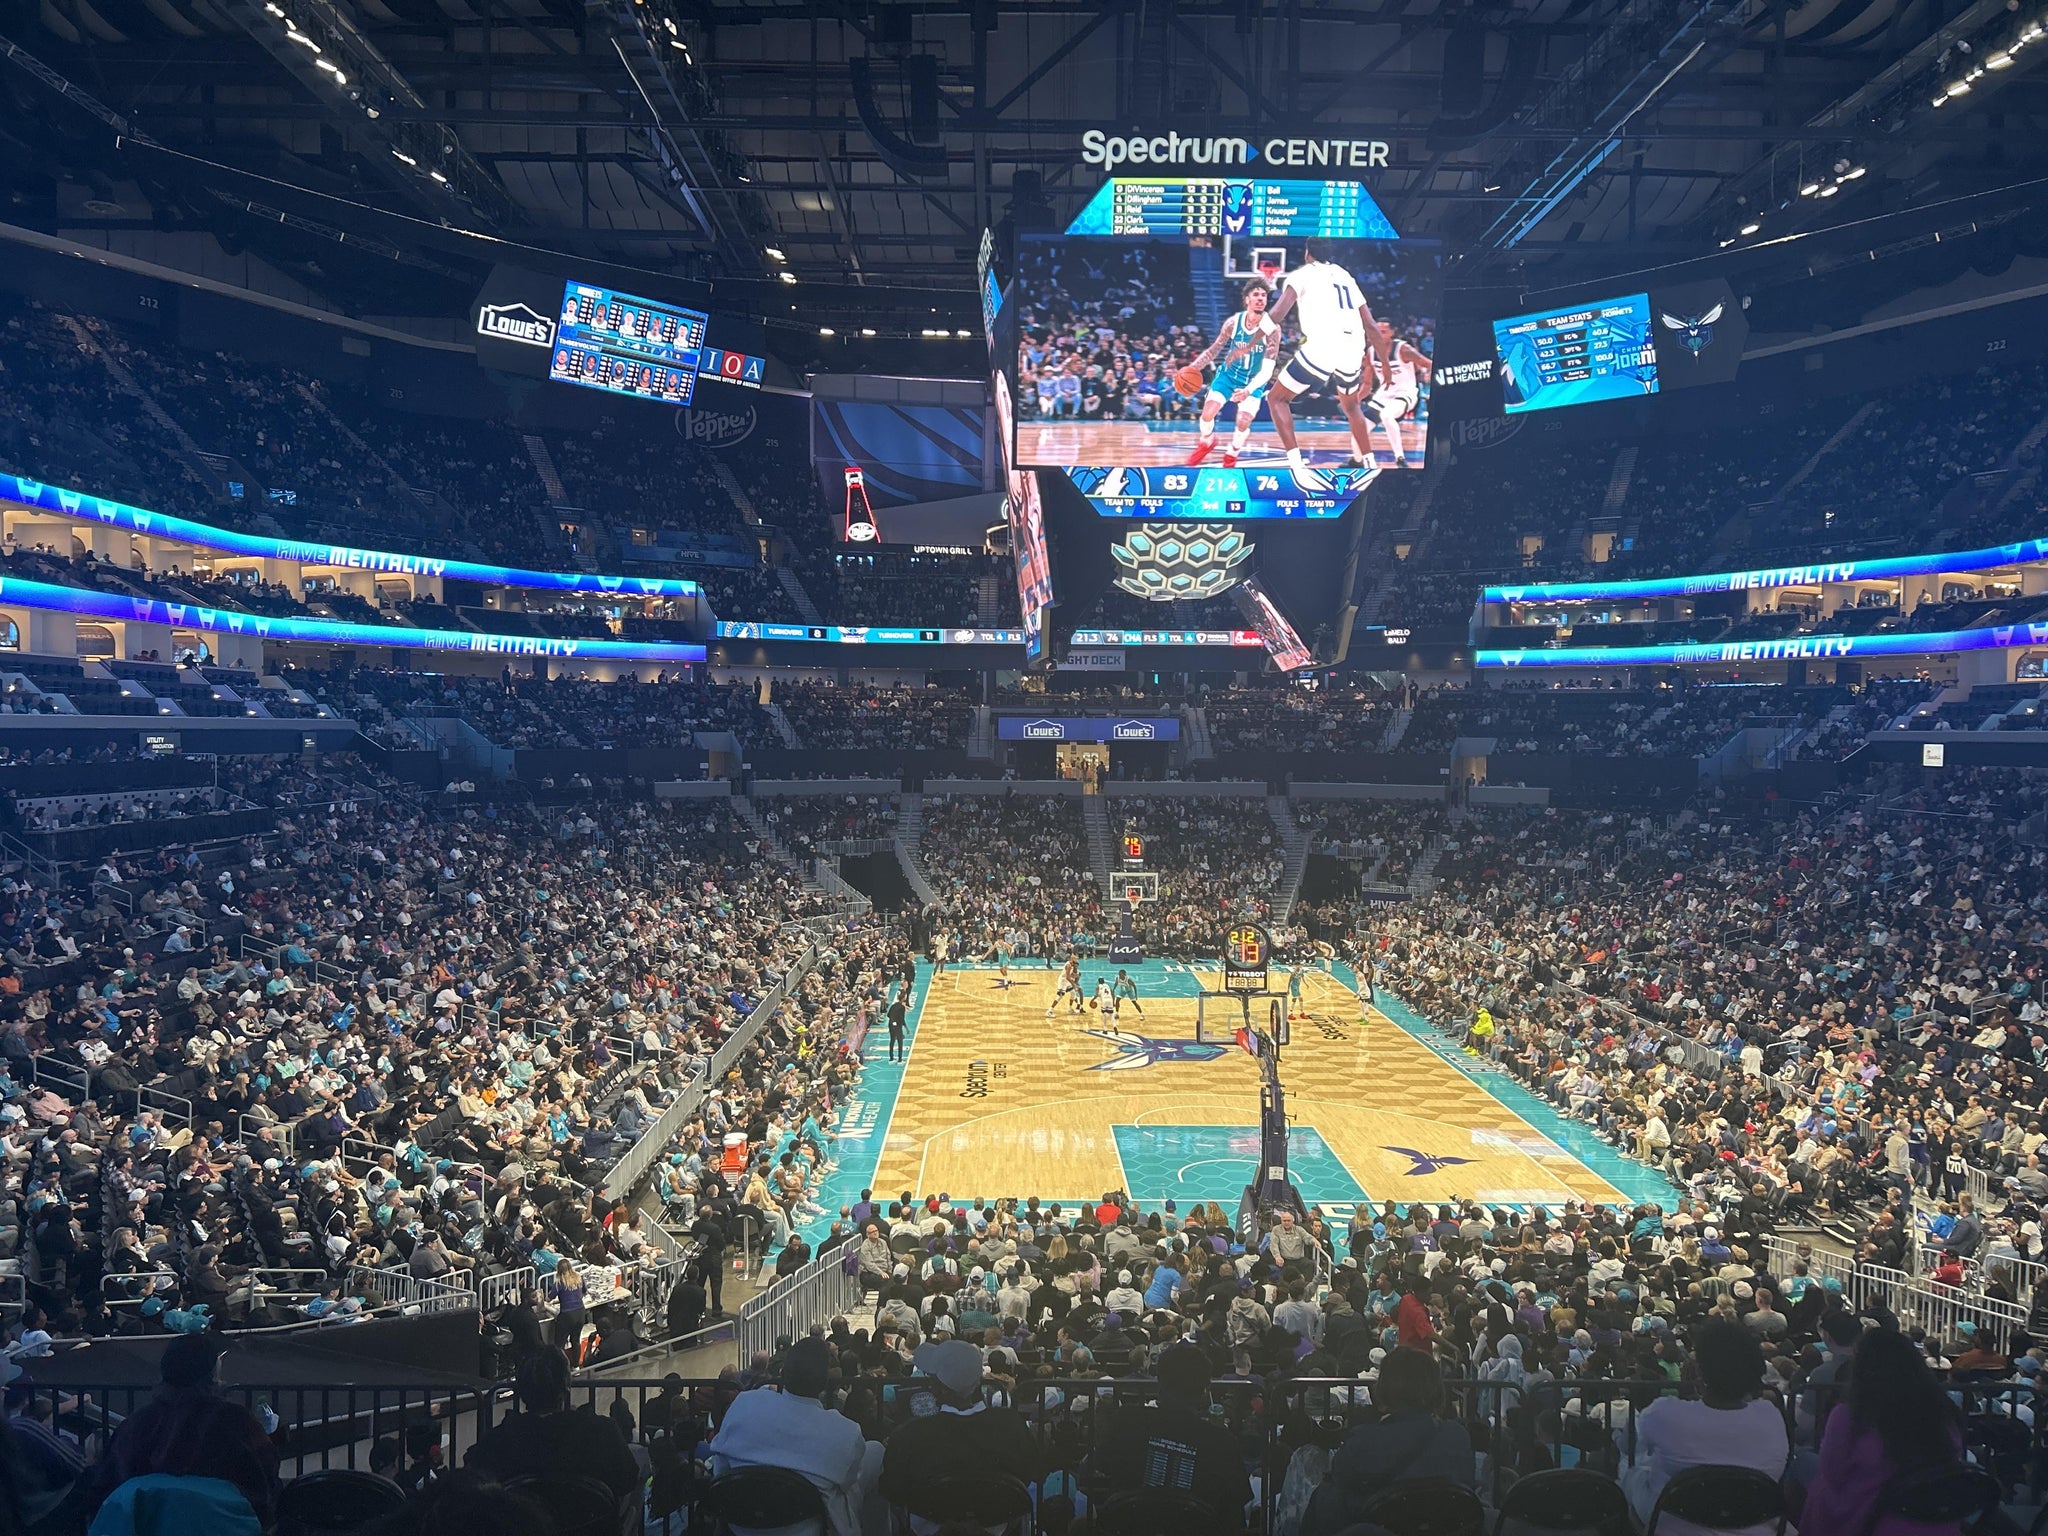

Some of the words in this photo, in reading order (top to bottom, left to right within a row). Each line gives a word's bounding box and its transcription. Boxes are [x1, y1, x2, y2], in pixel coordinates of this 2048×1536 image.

[1082, 130, 1249, 172] Spectrum
[1265, 139, 1390, 168] CENTER
[1116, 185, 1123, 193] 0
[1267, 186, 1281, 195] Ball
[1267, 197, 1289, 205] James
[1127, 205, 1142, 213] Reid
[1266, 207, 1298, 217] Knueppel
[1126, 216, 1144, 224] Clark
[1199, 216, 1207, 224] 0
[1211, 216, 1218, 224] 0
[1126, 226, 1149, 235] Gobert
[1332, 283, 1355, 310] 11
[139, 296, 159, 309] 212
[1546, 316, 1568, 327] TEAM
[1569, 312, 1592, 324] STATS
[486, 312, 548, 342] LOWE'S
[1537, 338, 1553, 346] 50.0
[1592, 327, 1608, 336] 40.6
[1986, 340, 2006, 352] 222
[1595, 353, 1614, 362] 100.0
[706, 350, 760, 380] IOA
[1454, 360, 1493, 375] NOVANT
[1455, 370, 1491, 383] HEALTH
[600, 416, 615, 425] 214
[684, 408, 746, 442] Pepper
[1544, 422, 1563, 431] 220
[765, 438, 779, 448] 215
[1163, 475, 1188, 490] 83
[1205, 478, 1238, 492] 21.4
[1256, 475, 1279, 491] 74
[1104, 499, 1123, 507] TEAM
[1123, 499, 1134, 507] TO
[1141, 499, 1163, 507] FOULS
[1202, 502, 1219, 511] 3rd
[1230, 503, 1241, 511] 13
[1277, 500, 1299, 509] FOULS
[1305, 500, 1323, 508] TEAM
[1323, 500, 1335, 508] TO
[680, 551, 699, 559] HIVE
[914, 546, 948, 554] UPTOWN
[949, 547, 972, 555] GRILL
[277, 542, 327, 564] HIVE
[328, 547, 446, 577] MENTALITY
[1684, 576, 1728, 595] HIVE
[1729, 562, 1855, 590] MENTALITY
[768, 628, 803, 636] TURNOVERS
[813, 630, 821, 638] 8
[878, 632, 914, 640] TURNOVERS
[981, 633, 995, 641] TOL
[996, 633, 1003, 641] 4
[1007, 633, 1021, 641] FLS
[424, 630, 469, 650] HIVE
[471, 633, 578, 656] MENTALITY
[1076, 633, 1098, 642] 21.3
[1106, 633, 1119, 642] 74
[1124, 633, 1142, 642] CHA
[1144, 634, 1157, 642] FLS
[1169, 634, 1183, 643] TOL
[1673, 648, 1719, 663] HIVE
[1721, 637, 1854, 660] MENTALITY
[1091, 655, 1121, 665] DECK
[1028, 727, 1060, 737] LOWE'S
[1118, 727, 1150, 738] LOWE'S
[1241, 943, 1259, 963] 13
[1238, 971, 1266, 979] TISSOT
[994, 1063, 1007, 1079] CENTER
[959, 1063, 995, 1099] Spectrum
